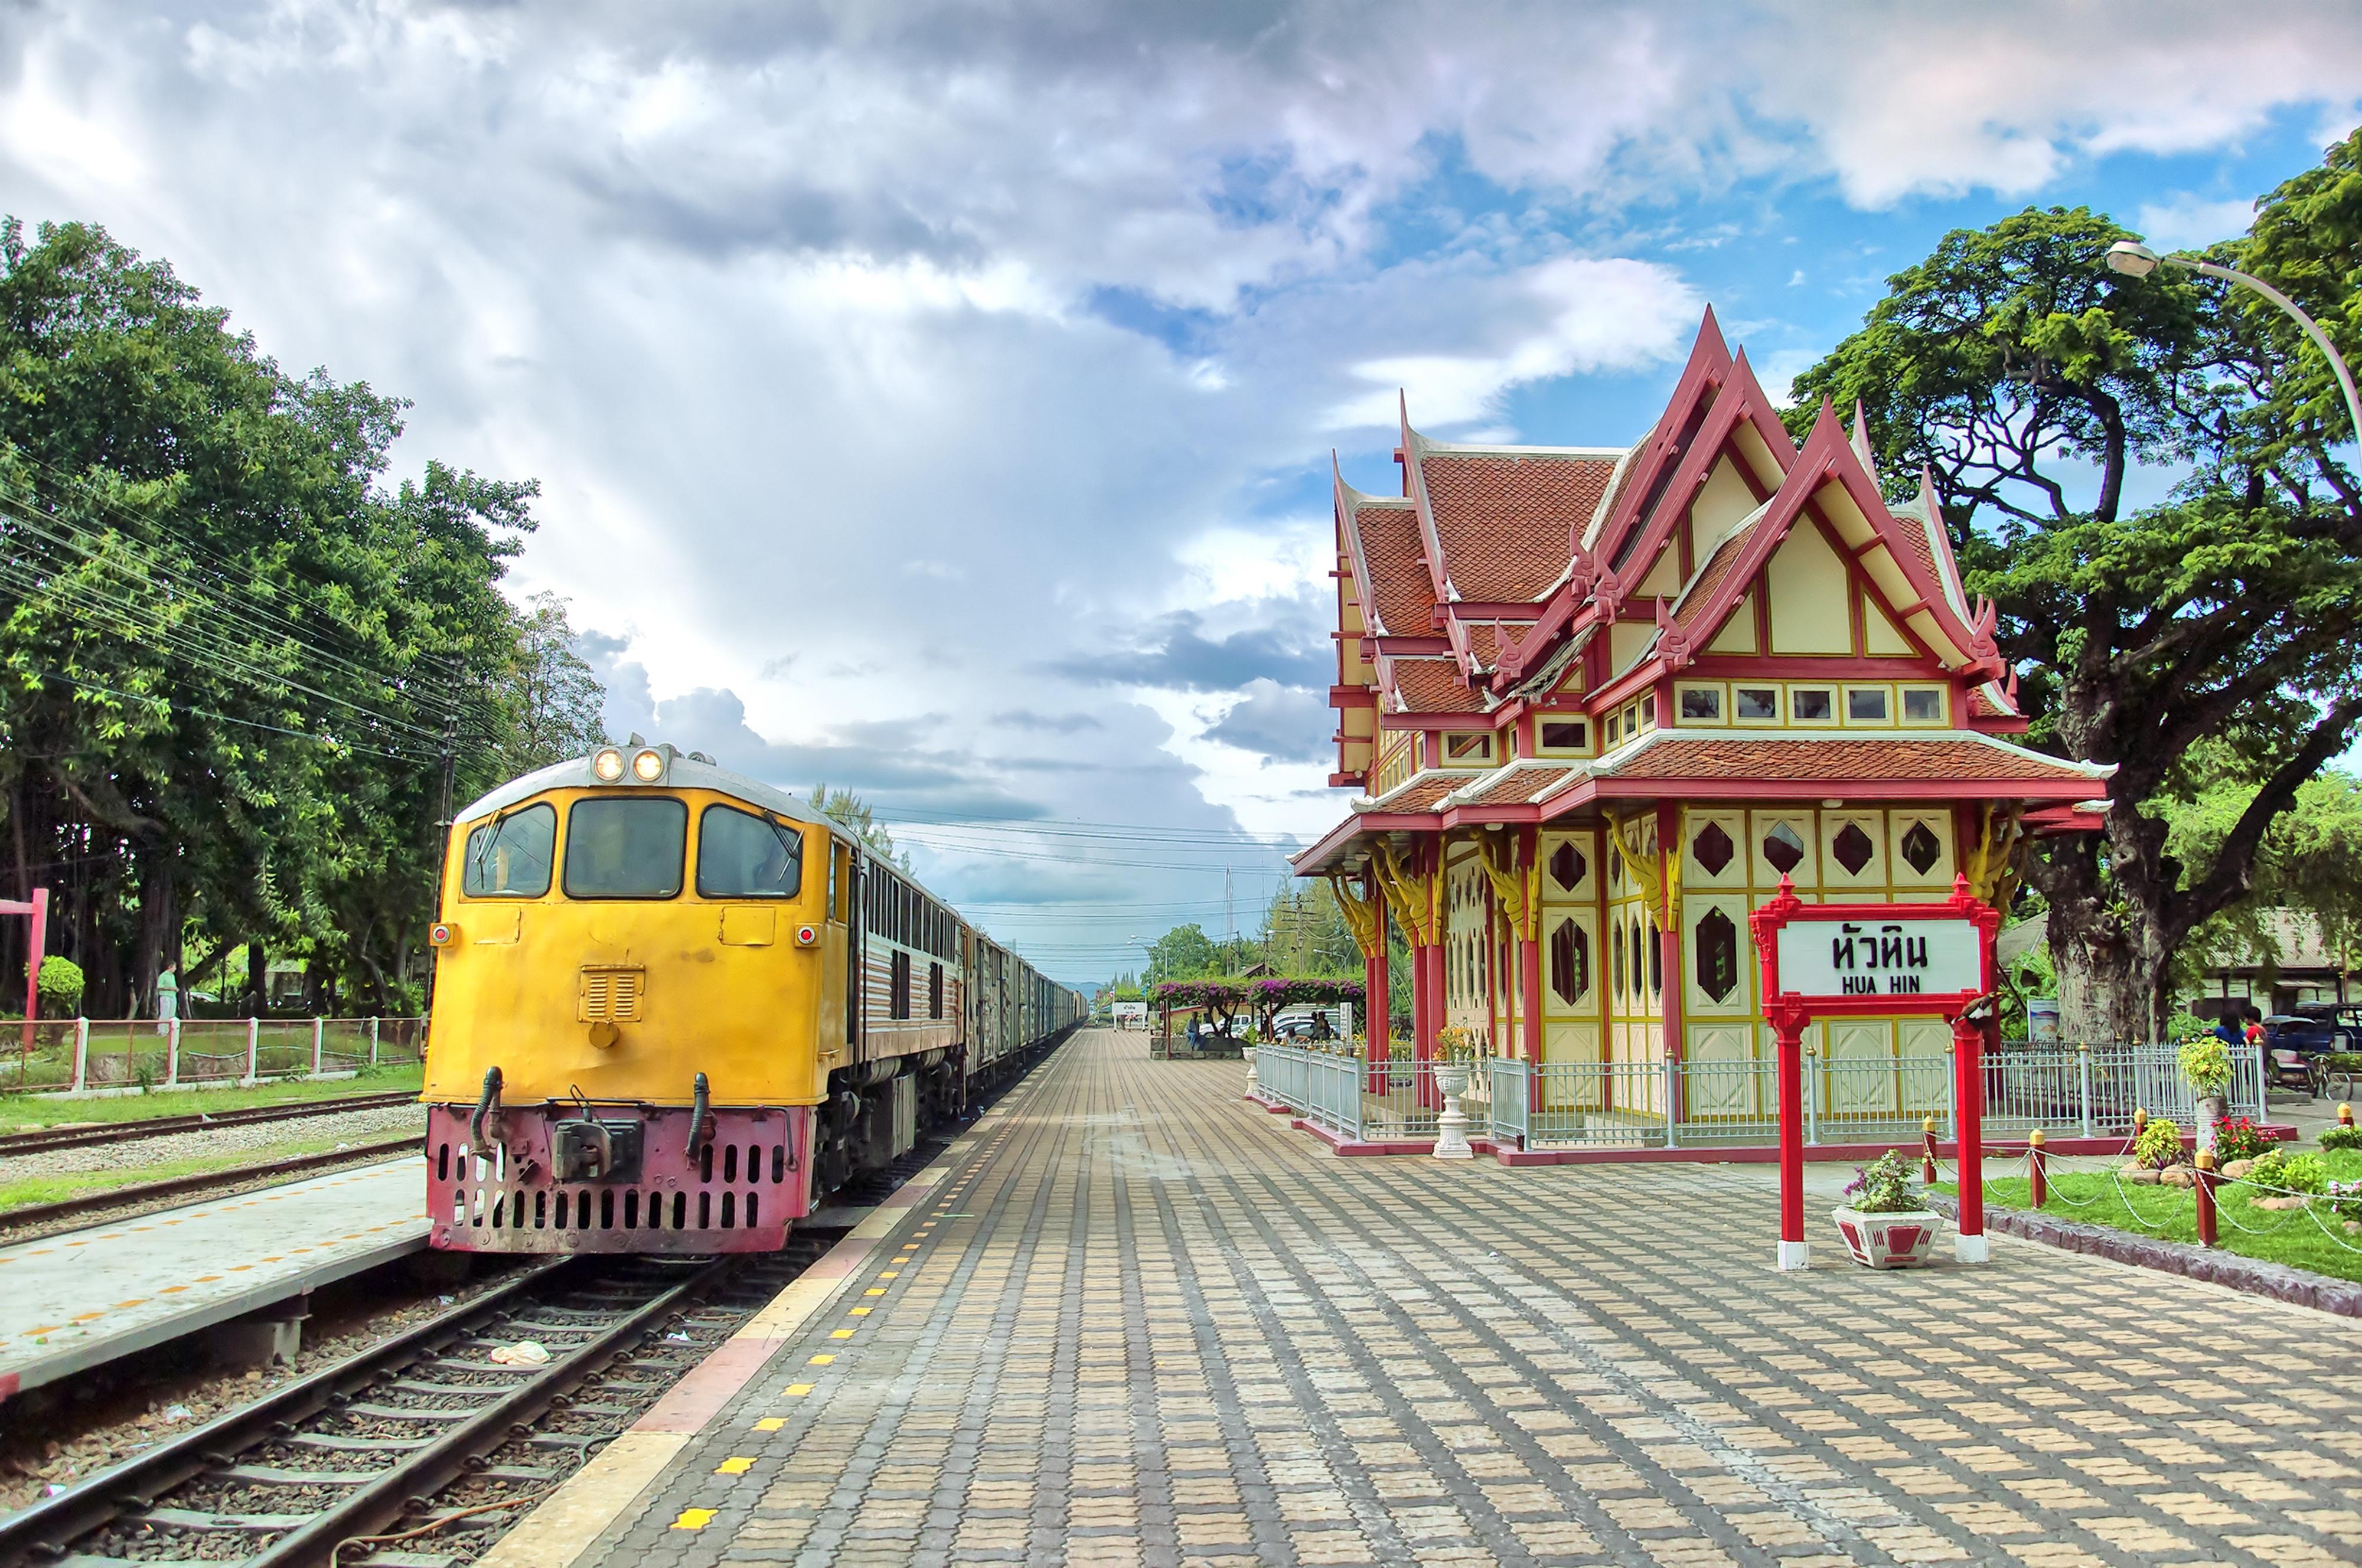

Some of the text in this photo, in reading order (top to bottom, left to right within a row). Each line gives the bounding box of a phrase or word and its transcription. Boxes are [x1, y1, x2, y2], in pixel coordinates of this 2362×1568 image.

[1832, 923, 1928, 969] หัวหิน
[1842, 975, 1920, 994] HUA HIN
